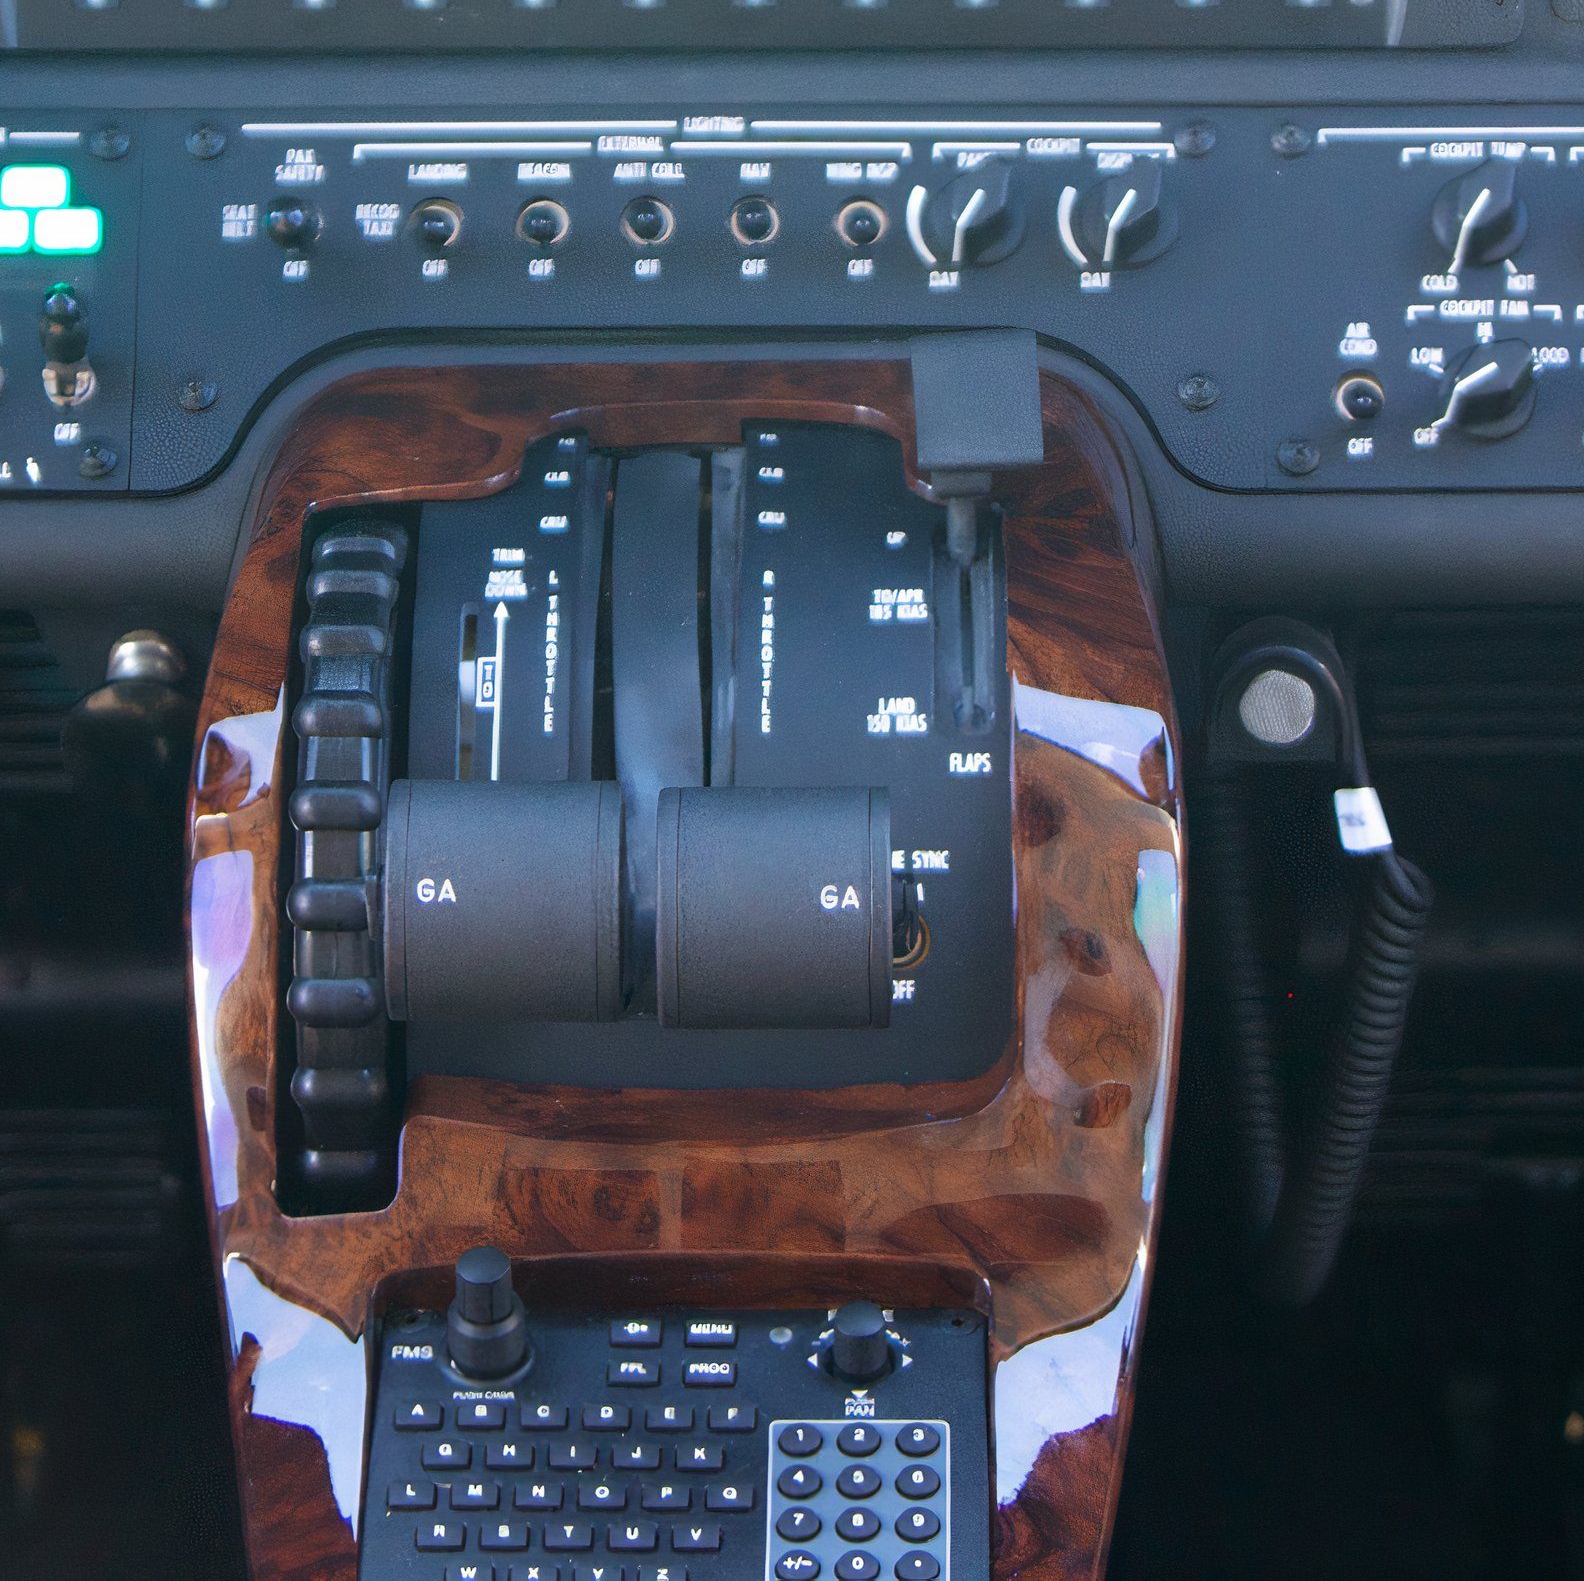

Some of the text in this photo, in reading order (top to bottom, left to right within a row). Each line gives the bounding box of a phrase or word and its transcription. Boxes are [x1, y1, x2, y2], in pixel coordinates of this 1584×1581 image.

[1421, 274, 1459, 291] COLD
[1347, 438, 1374, 454] OFF
[548, 571, 559, 584] L
[762, 571, 774, 585] R
[877, 698, 916, 716] LAND
[949, 752, 992, 774] FLAPS
[912, 850, 950, 870] SYNC
[417, 879, 456, 904] GA
[820, 885, 860, 910] GA
[411, 1404, 424, 1416] A
[845, 1404, 875, 1417] PAN
[796, 1429, 804, 1441] 1
[854, 1429, 864, 1441] 2
[632, 1447, 642, 1459] J
[694, 1447, 705, 1460] K
[406, 1484, 416, 1496] L
[468, 1485, 483, 1497] M
[532, 1486, 545, 1498] N
[793, 1513, 804, 1525] 7
[563, 1526, 574, 1538] T
[627, 1527, 639, 1540] U
[691, 1528, 702, 1541] V
[852, 1557, 864, 1569] 0
[461, 1566, 477, 1579] W
[528, 1567, 540, 1580] X
